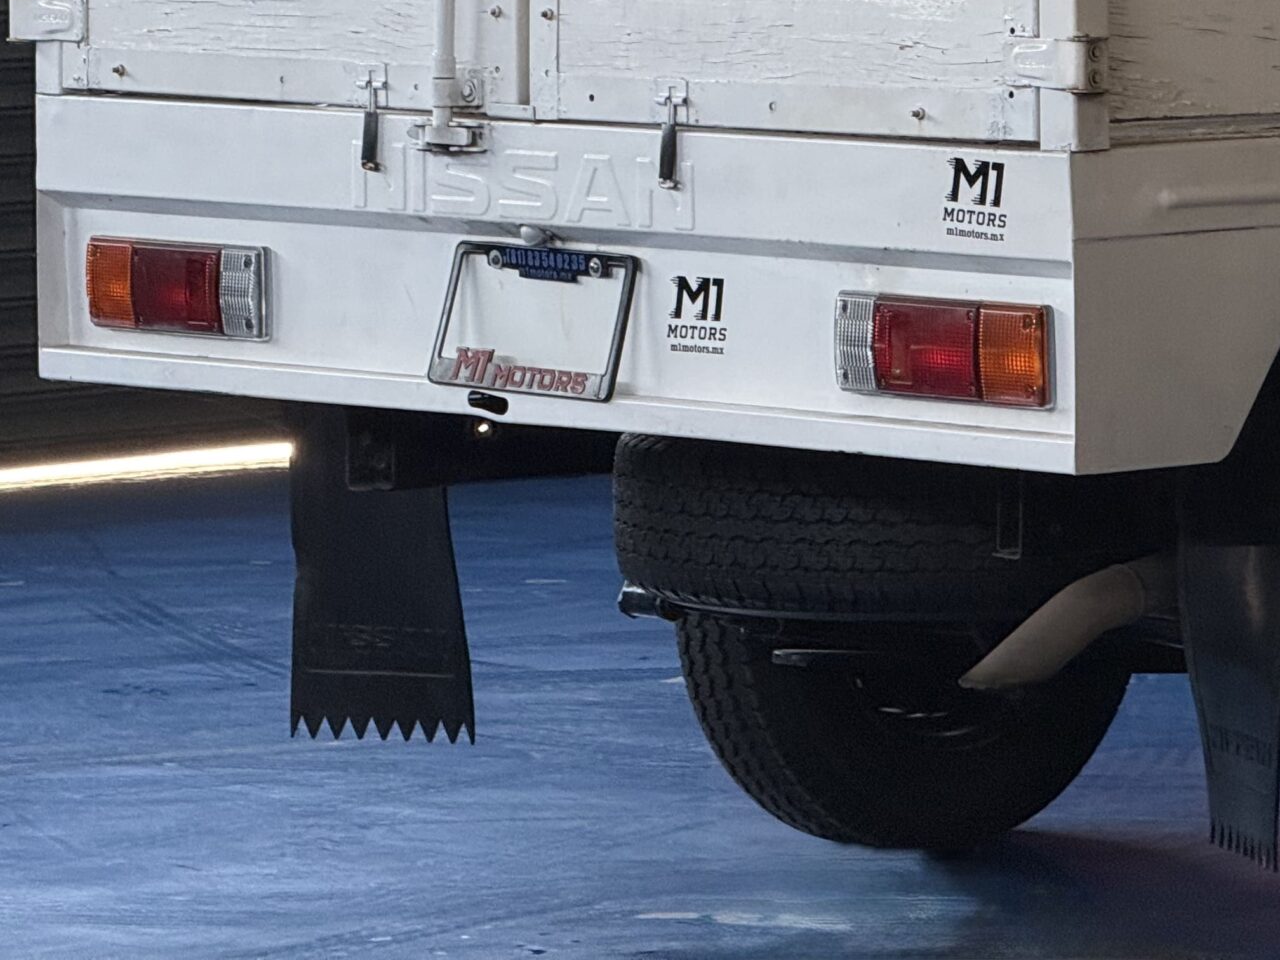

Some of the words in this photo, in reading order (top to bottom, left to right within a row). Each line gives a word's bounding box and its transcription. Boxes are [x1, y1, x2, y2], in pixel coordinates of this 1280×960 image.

[350, 139, 696, 231] NISSAN
[945, 157, 1005, 208] M1
[942, 207, 1008, 229] MOTORS
[946, 227, 1005, 241] m1motors.mx
[668, 275, 725, 322] M1
[667, 324, 728, 342] MOTORS
[670, 343, 725, 355] m1motors.mx
[449, 346, 495, 384] M1
[490, 363, 588, 394] MOTORS
